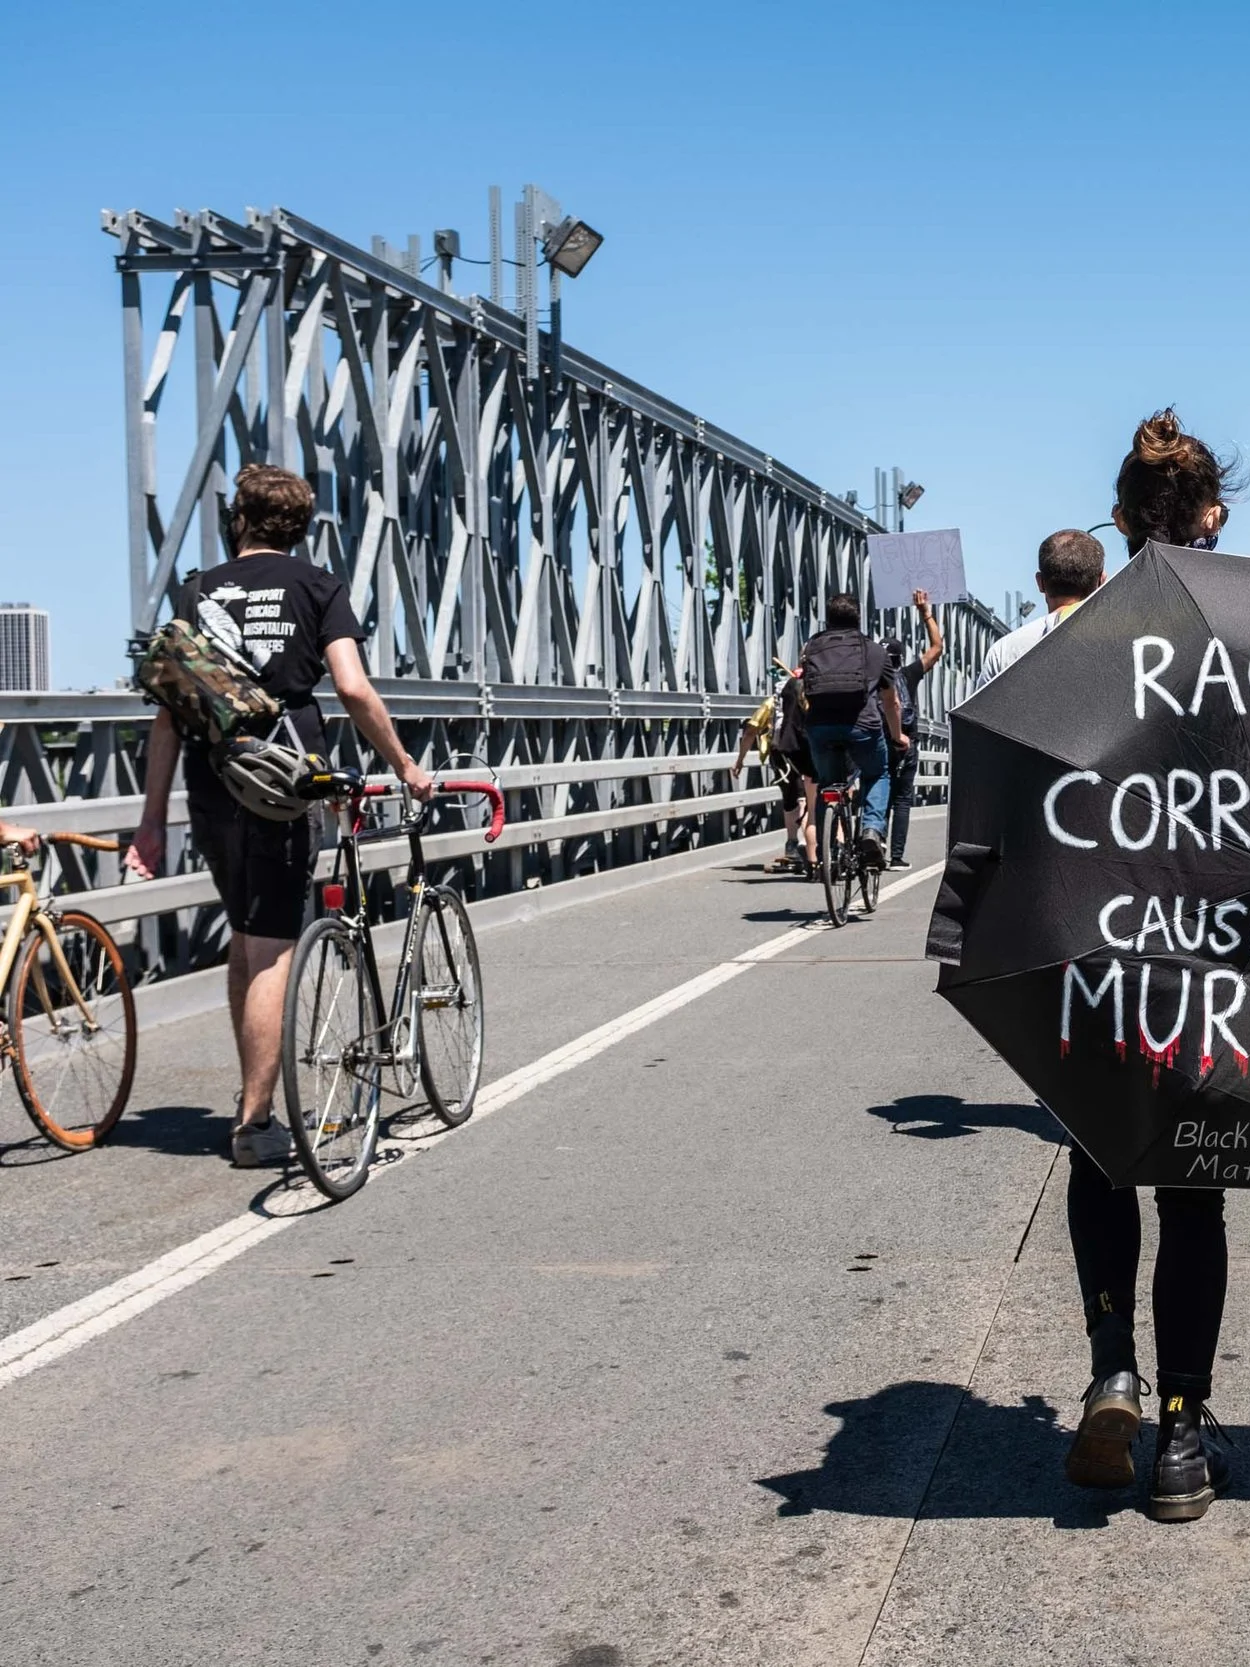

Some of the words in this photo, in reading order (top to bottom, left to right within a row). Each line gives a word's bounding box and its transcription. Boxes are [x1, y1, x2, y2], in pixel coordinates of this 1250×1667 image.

[877, 533, 962, 575] FUCK
[247, 588, 286, 602] SUPPORT
[245, 604, 281, 619] CHICAGO
[243, 622, 296, 636] HOSPITALITY
[1173, 1120, 1249, 1150] Black
